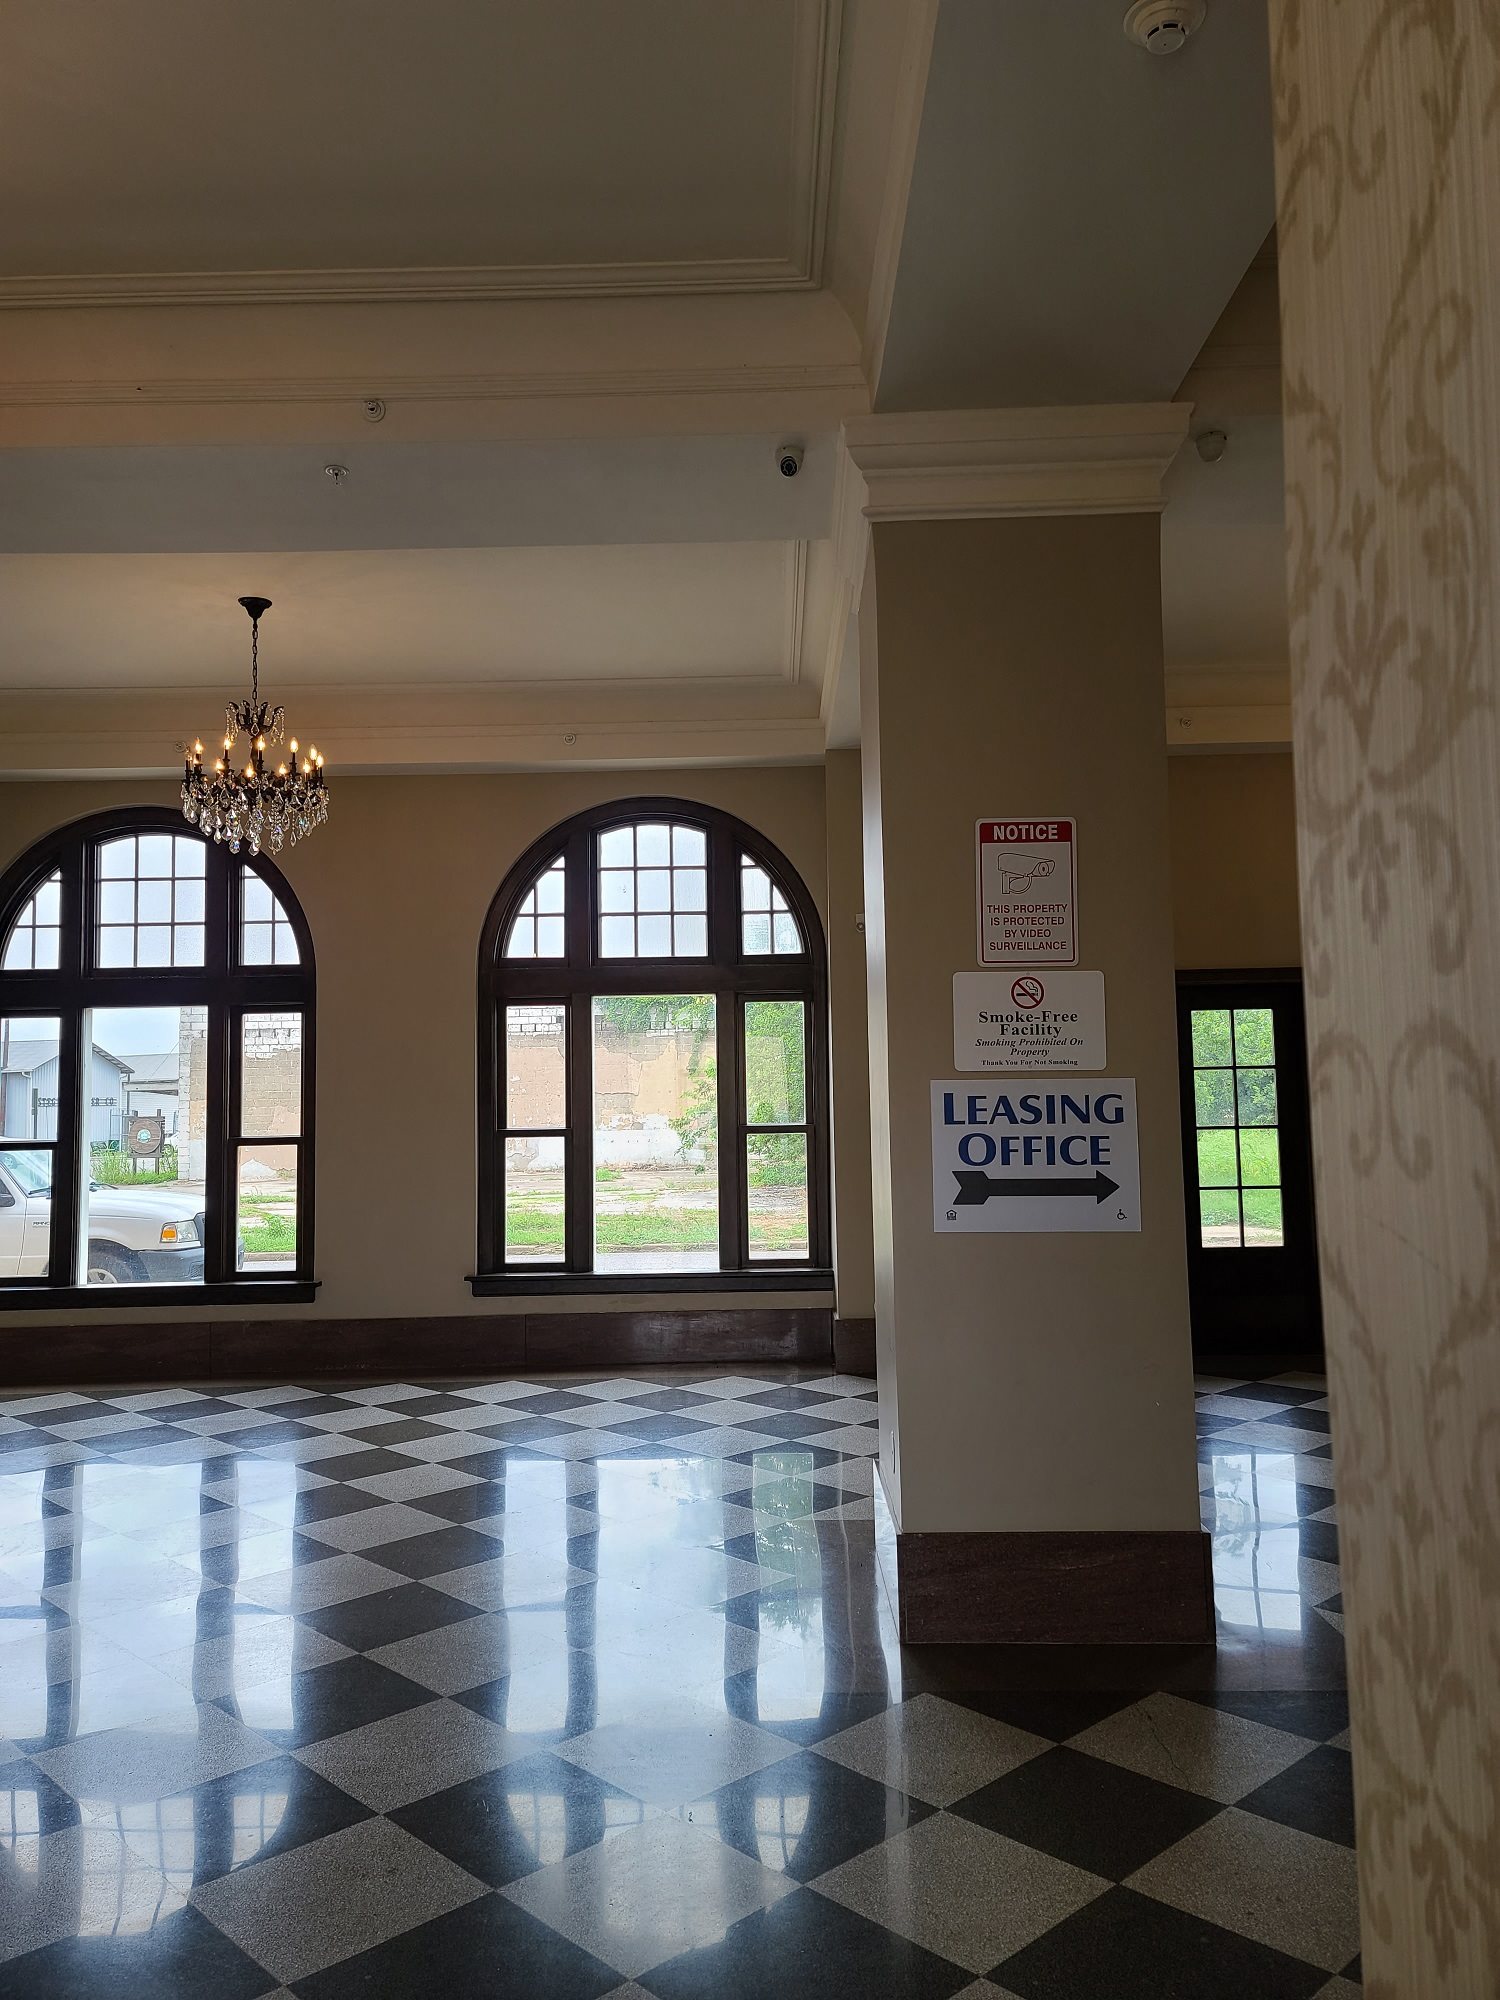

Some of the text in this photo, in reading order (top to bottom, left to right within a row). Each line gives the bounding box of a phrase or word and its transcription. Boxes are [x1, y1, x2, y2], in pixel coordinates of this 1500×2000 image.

[993, 825, 1058, 840] NOTICE
[987, 904, 1068, 913] THIS PROPERTY
[1004, 917, 1065, 925] PROTECTED
[1005, 929, 1051, 938] BY VIDEO
[989, 941, 1067, 950] SURVEILLANCE
[979, 1011, 1078, 1023] Smoke-Free
[1000, 1024, 1062, 1038] Facility
[975, 1039, 1016, 1047] Smoking
[1019, 1038, 1067, 1046] Prohibited
[1010, 1048, 1050, 1057] Property
[943, 1093, 1124, 1125] LEASING
[958, 1133, 1111, 1166] OFFICE
